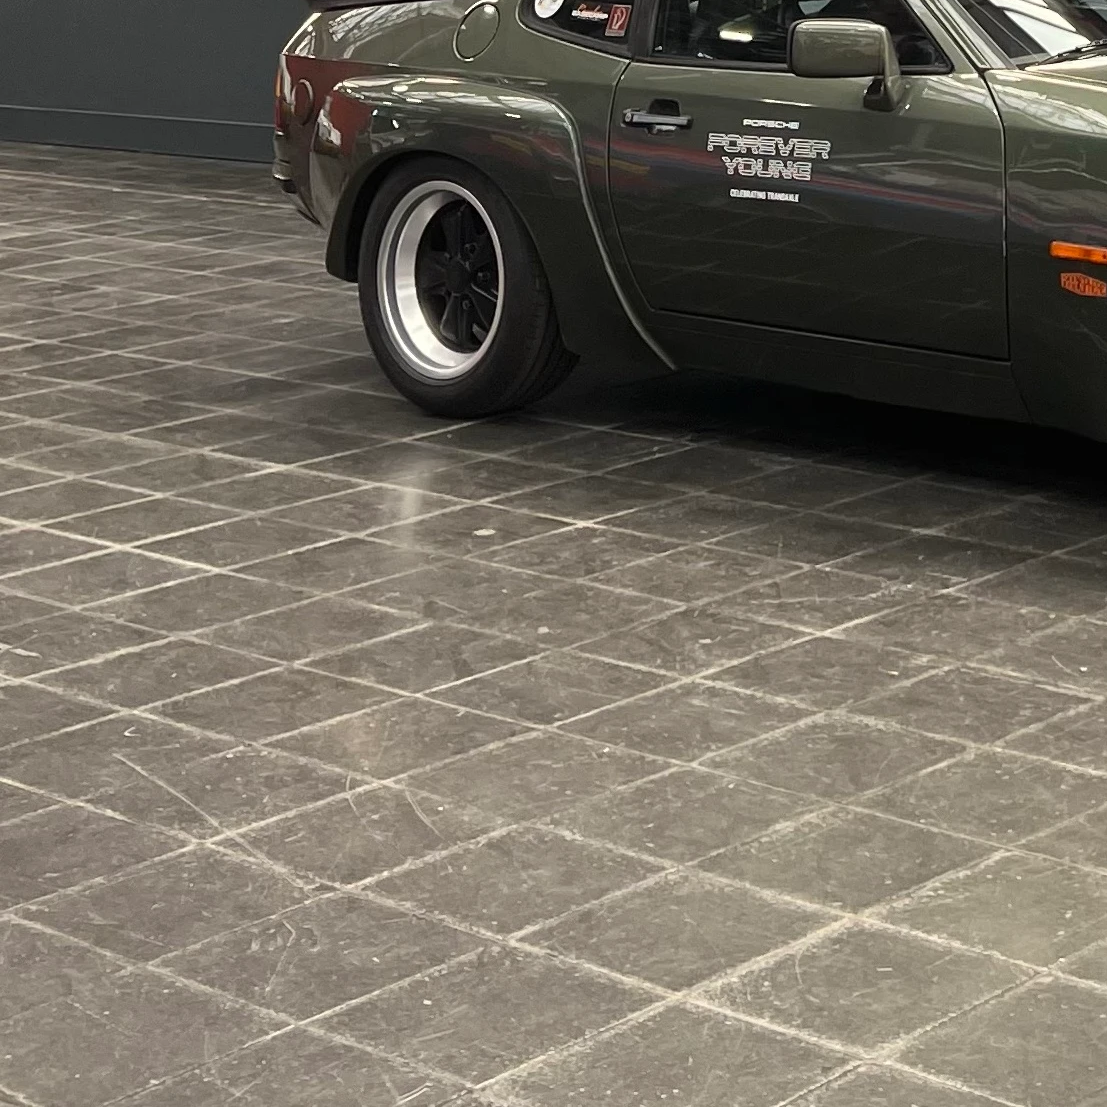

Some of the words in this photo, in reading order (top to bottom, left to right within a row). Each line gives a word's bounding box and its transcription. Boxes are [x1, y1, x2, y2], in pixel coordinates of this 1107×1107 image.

[743, 118, 800, 130] PORSCHE
[707, 133, 831, 159] FOREVER
[722, 156, 812, 181] YOUNG
